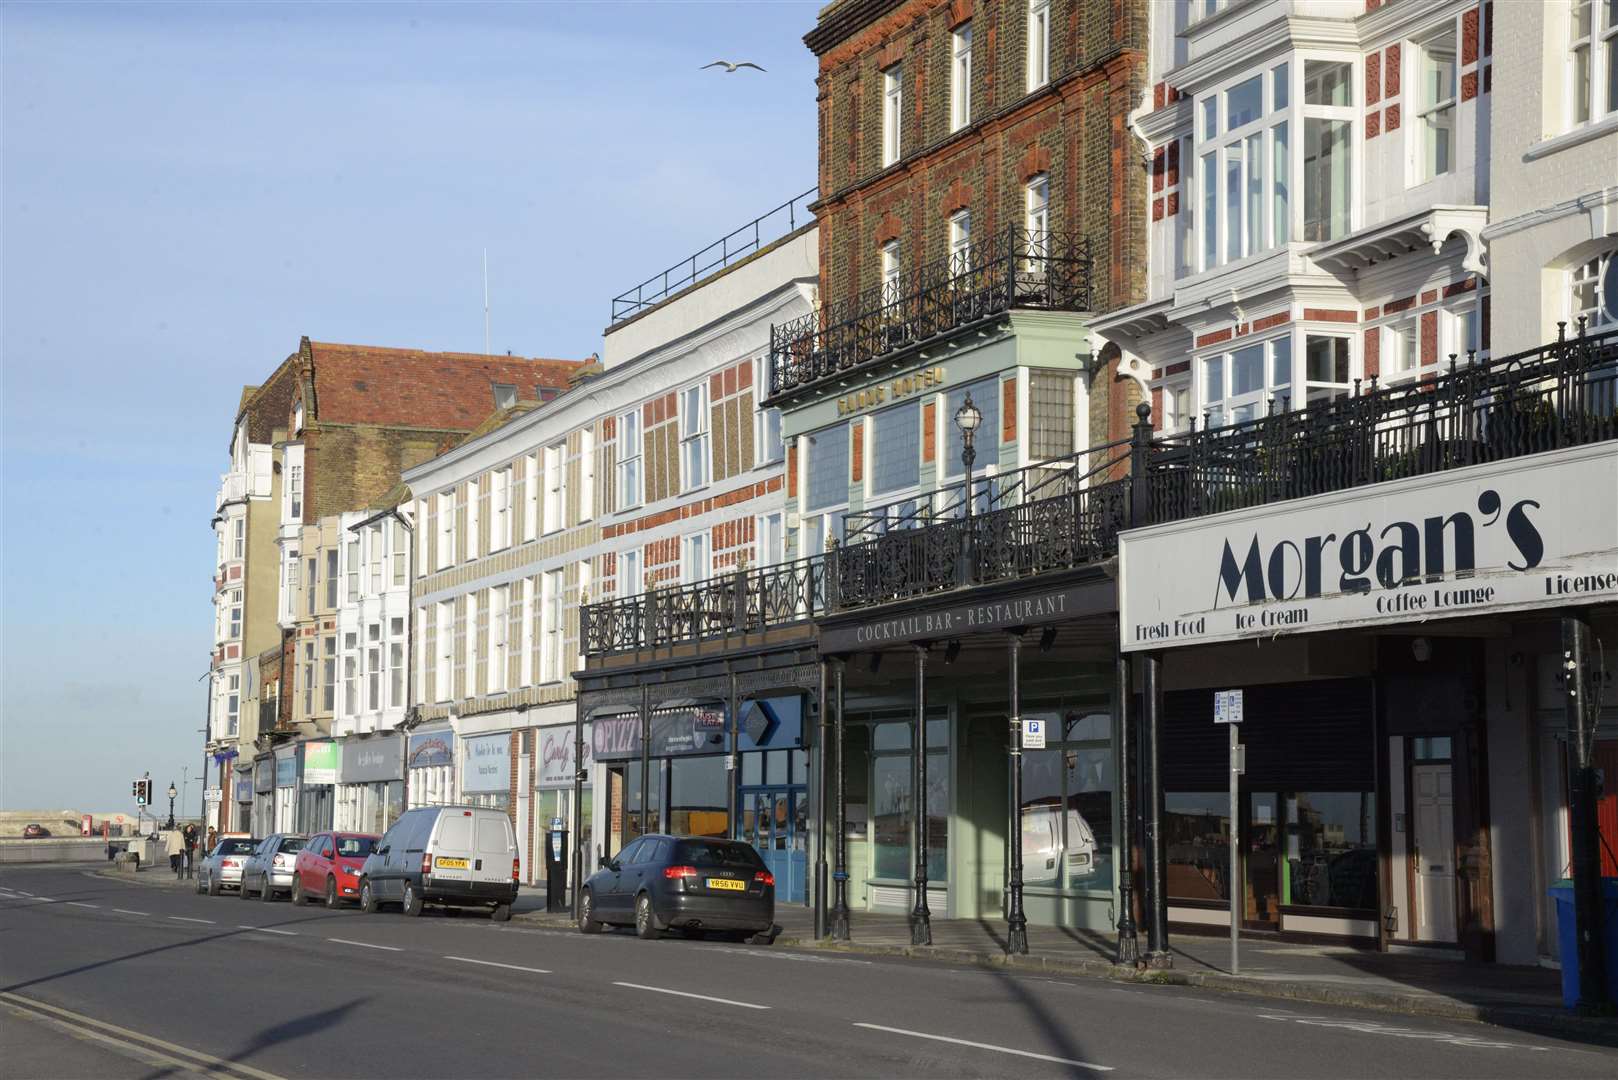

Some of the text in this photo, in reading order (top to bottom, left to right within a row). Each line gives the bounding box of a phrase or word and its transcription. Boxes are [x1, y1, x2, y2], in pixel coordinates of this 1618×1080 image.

[891, 367, 943, 400] HOTEL
[1213, 489, 1544, 611] Morgan's
[1545, 572, 1618, 596] License
[1376, 585, 1495, 613] Coffee Lounge
[857, 617, 921, 643] COCKTAIL
[926, 612, 952, 633] BAR
[968, 594, 1066, 625] RESTAURANT
[1136, 616, 1206, 641] Fresh Food
[1235, 607, 1308, 630] Ice Cream
[711, 879, 729, 888] YR56
